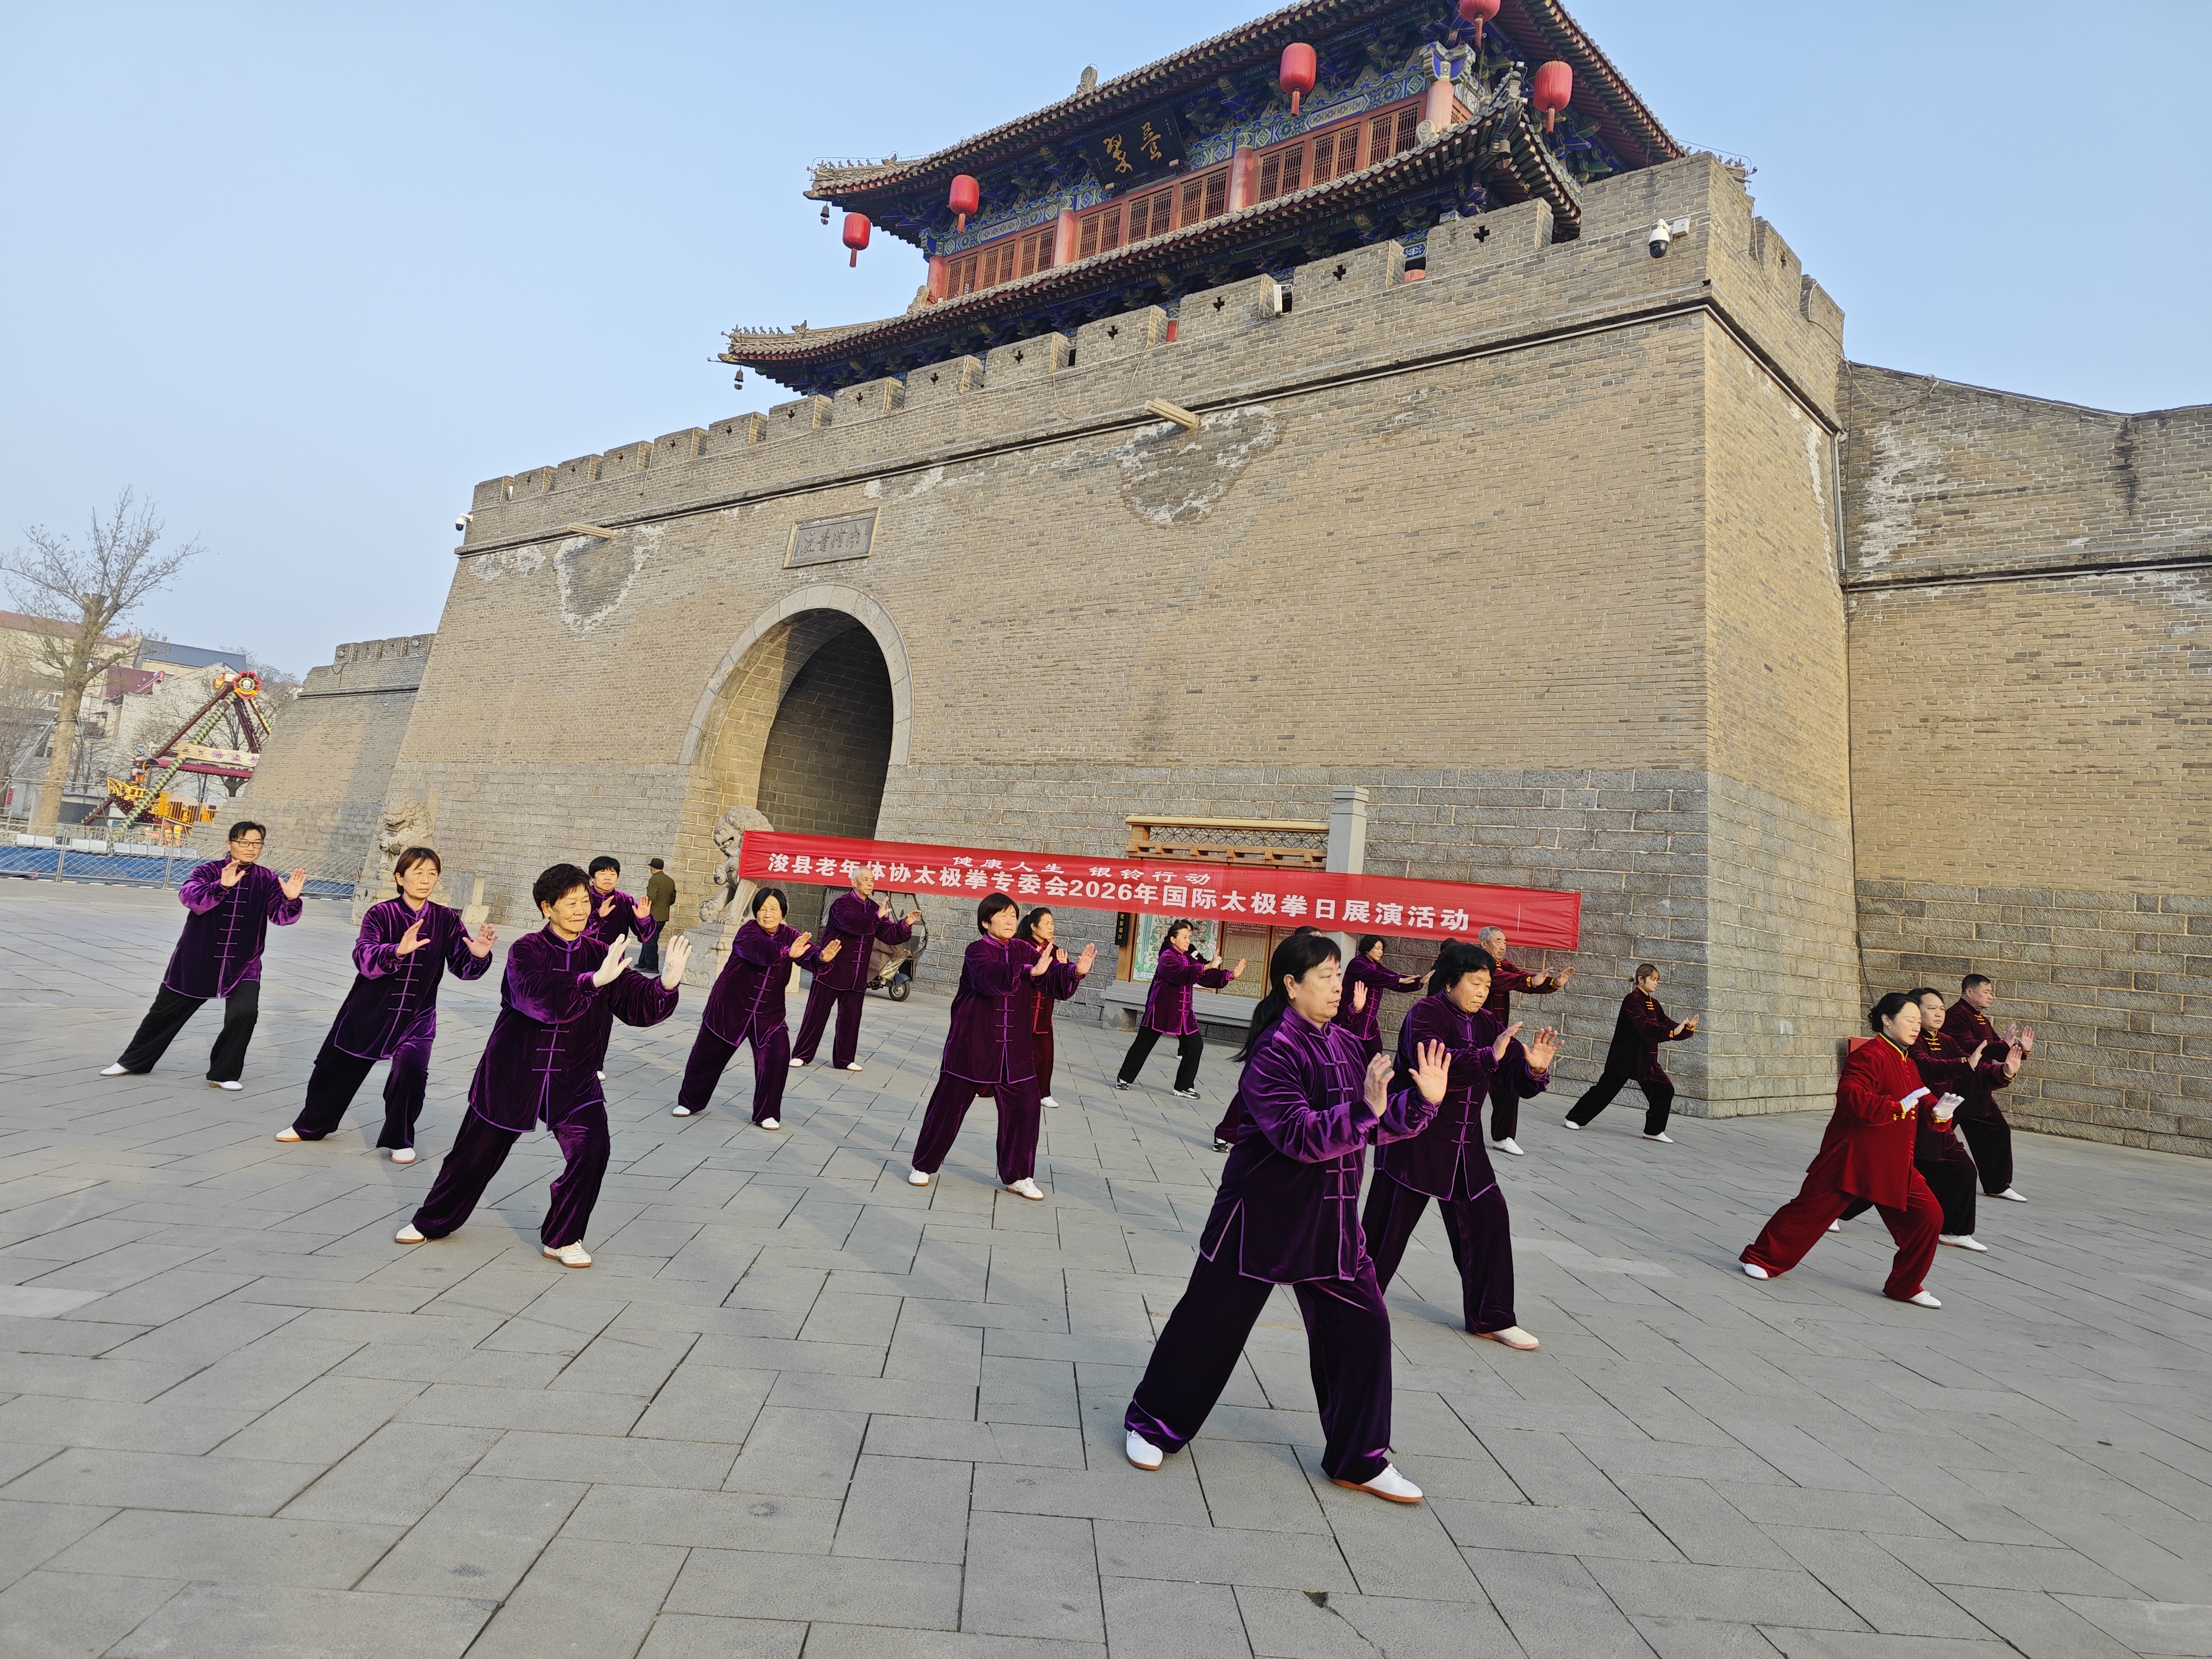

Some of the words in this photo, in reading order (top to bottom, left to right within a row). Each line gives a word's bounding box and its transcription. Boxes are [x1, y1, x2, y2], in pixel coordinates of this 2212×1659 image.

[767, 852, 1469, 932] 浚县老年体协太极拳专委会2026年国际太极拳日展演活动
[952, 856, 1065, 874] 健康人生
[1089, 866, 1210, 886] 银铃行动
